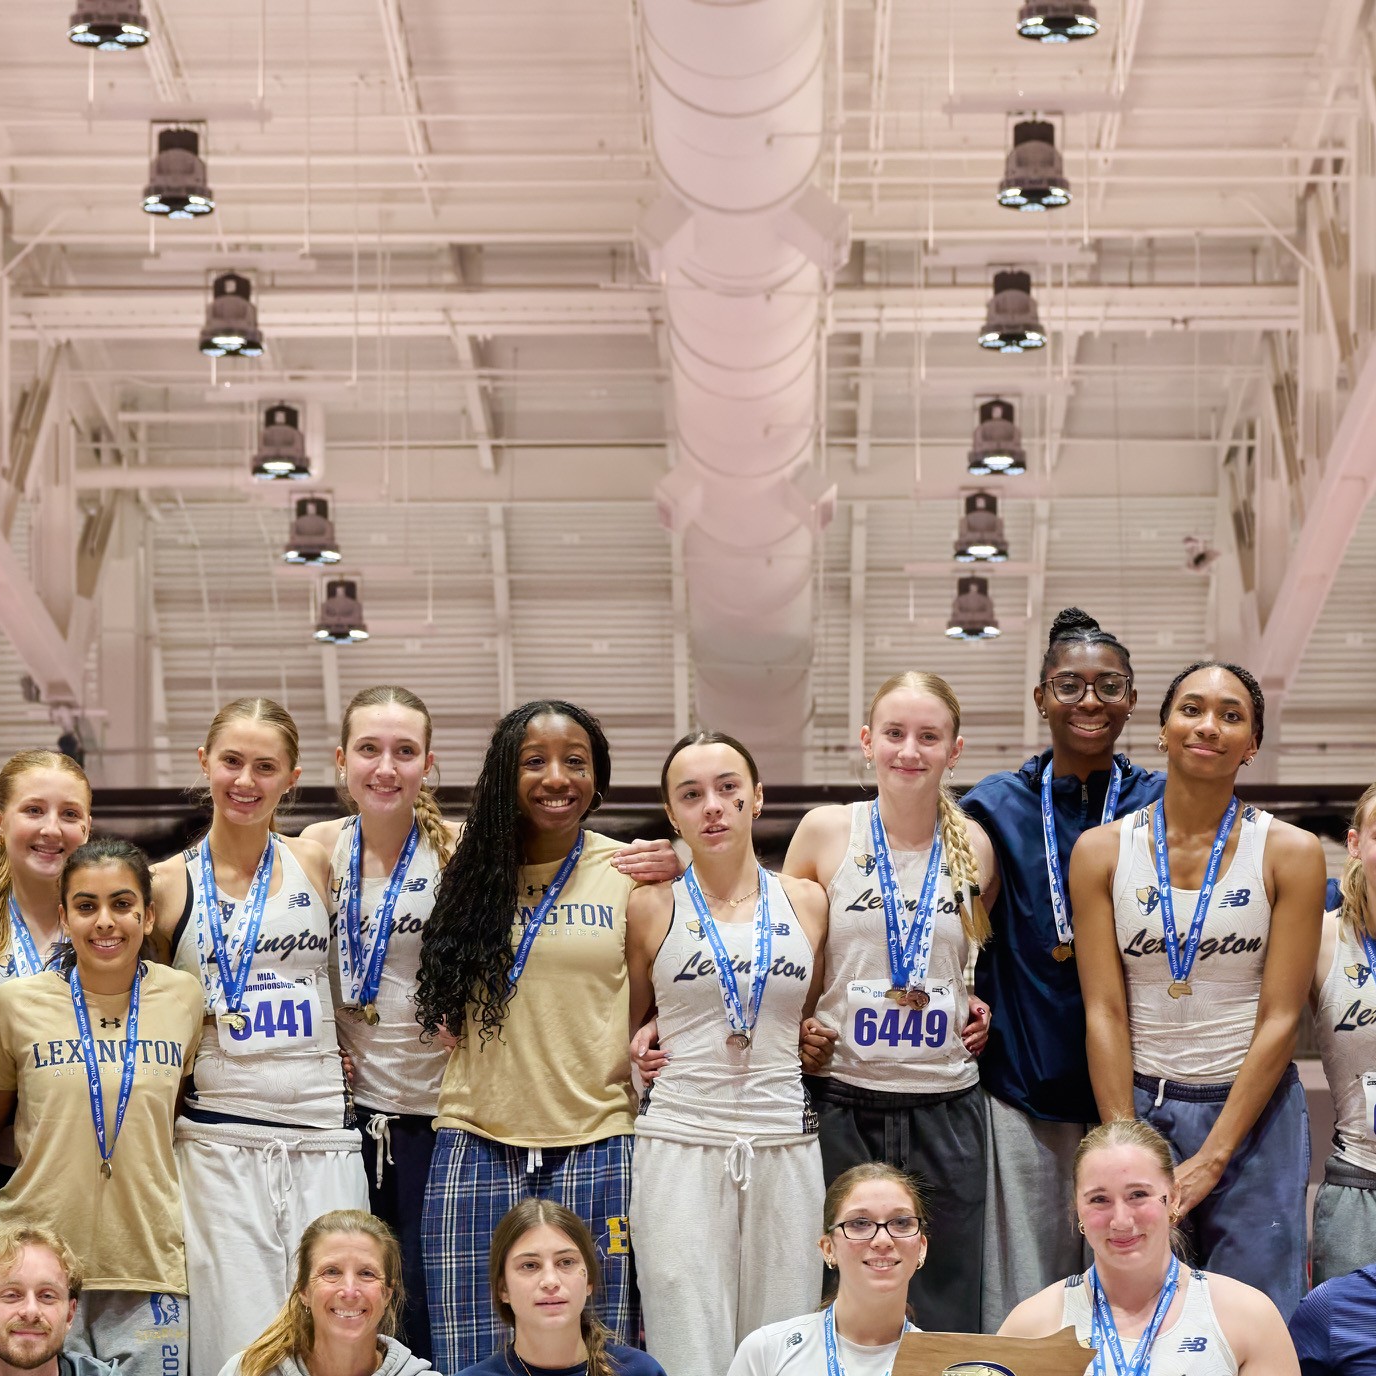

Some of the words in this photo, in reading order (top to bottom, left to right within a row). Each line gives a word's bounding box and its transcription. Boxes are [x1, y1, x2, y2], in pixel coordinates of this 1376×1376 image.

[845, 888, 961, 913] Lento
[1124, 928, 1262, 961] Lexigton
[257, 973, 276, 982] MIAA
[674, 951, 807, 983] Leinton
[243, 982, 296, 993] hampionships
[229, 1000, 312, 1041] 6441
[854, 1007, 948, 1049] 6449
[32, 1039, 182, 1069] LEXNTON
